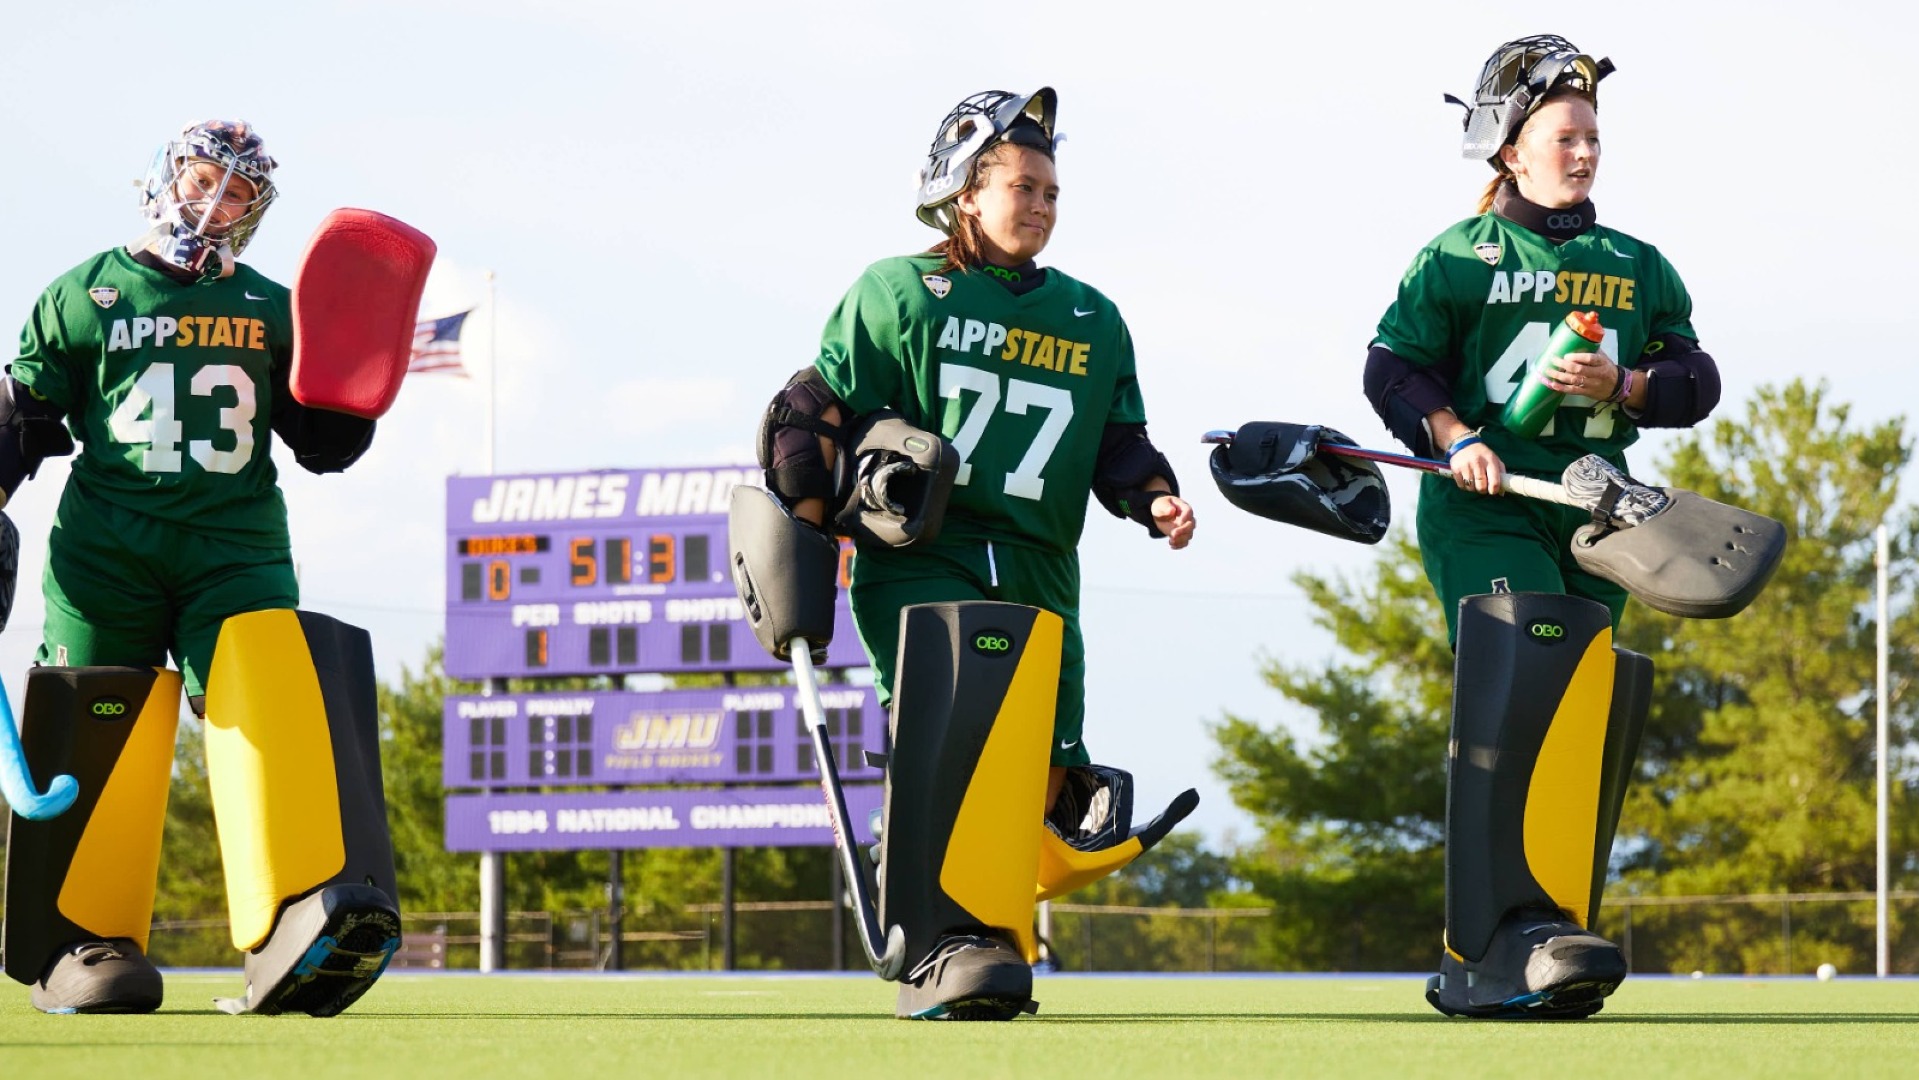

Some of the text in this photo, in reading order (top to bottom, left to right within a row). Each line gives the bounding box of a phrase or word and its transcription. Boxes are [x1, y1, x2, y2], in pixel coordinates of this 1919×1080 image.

[926, 174, 954, 195] OBO
[1547, 214, 1582, 229] OBO
[109, 362, 256, 474] 43
[939, 363, 1075, 501] 77
[472, 474, 630, 523] JAMES
[512, 604, 560, 627] PER
[1532, 623, 1563, 637] OBO
[976, 636, 1009, 650] OBO
[93, 703, 125, 715] OBO
[525, 699, 595, 716] PENALTY
[612, 709, 725, 752] JMU
[556, 806, 680, 833] NATIONAL
